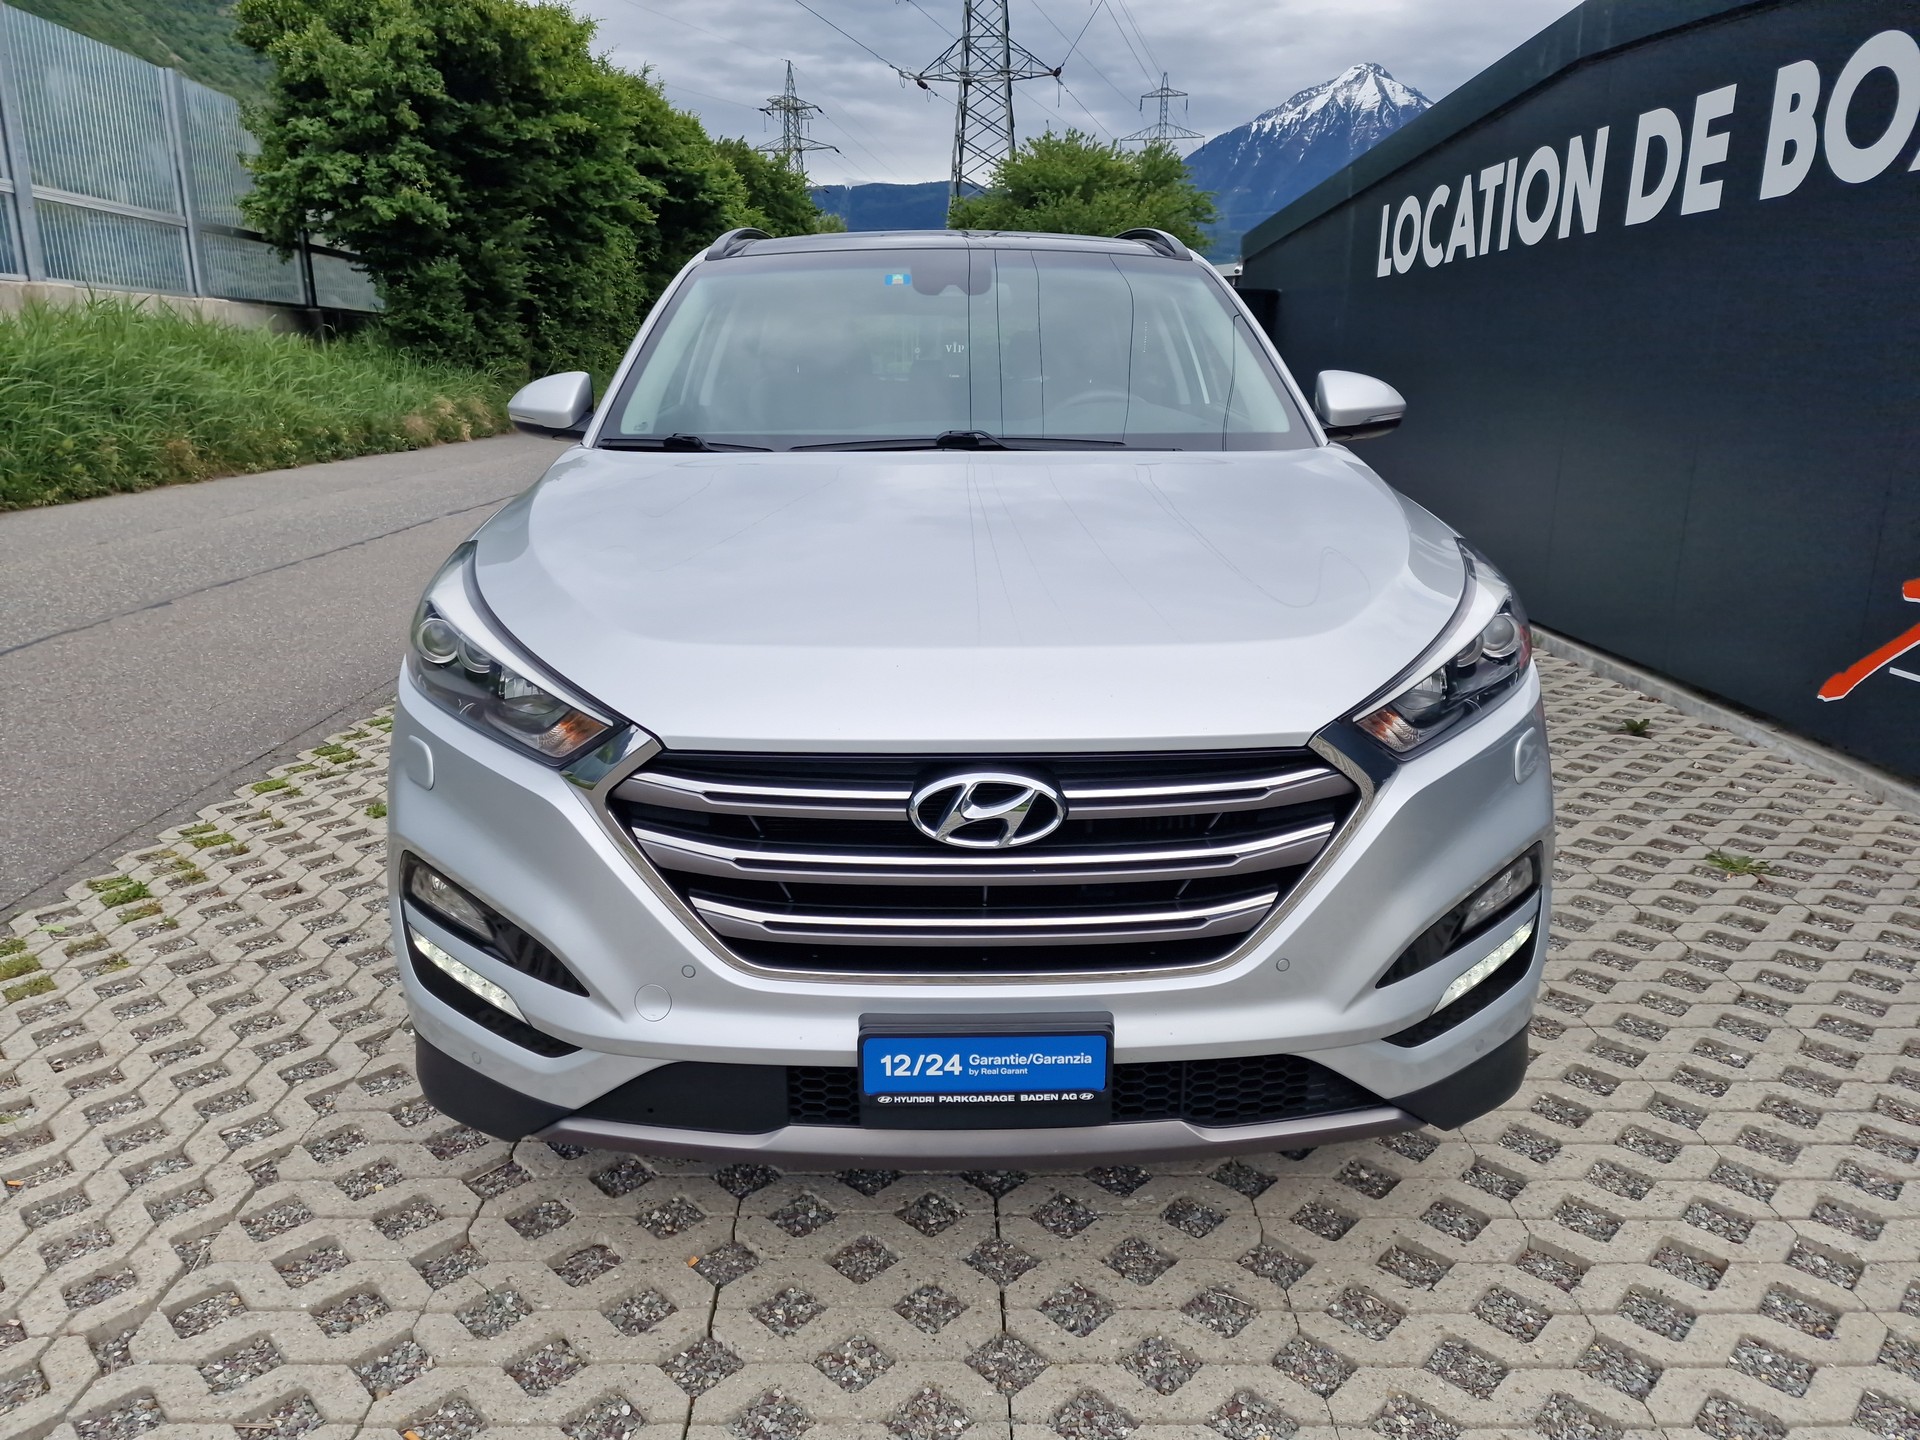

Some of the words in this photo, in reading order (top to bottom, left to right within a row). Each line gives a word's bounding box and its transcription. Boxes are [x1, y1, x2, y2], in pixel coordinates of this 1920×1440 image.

[1377, 125, 1609, 277] LOCATION
[1625, 83, 1737, 226] DE
[1759, 30, 1920, 200] BO
[880, 1054, 963, 1077] 12/24
[969, 1052, 1092, 1066] Garantie/Garanzia
[968, 1068, 979, 1076] by
[1000, 1067, 1028, 1075] Garant
[938, 1095, 1016, 1103] PARKGARAGE
[1020, 1093, 1059, 1102] BADEN
[1061, 1093, 1077, 1101] AG
